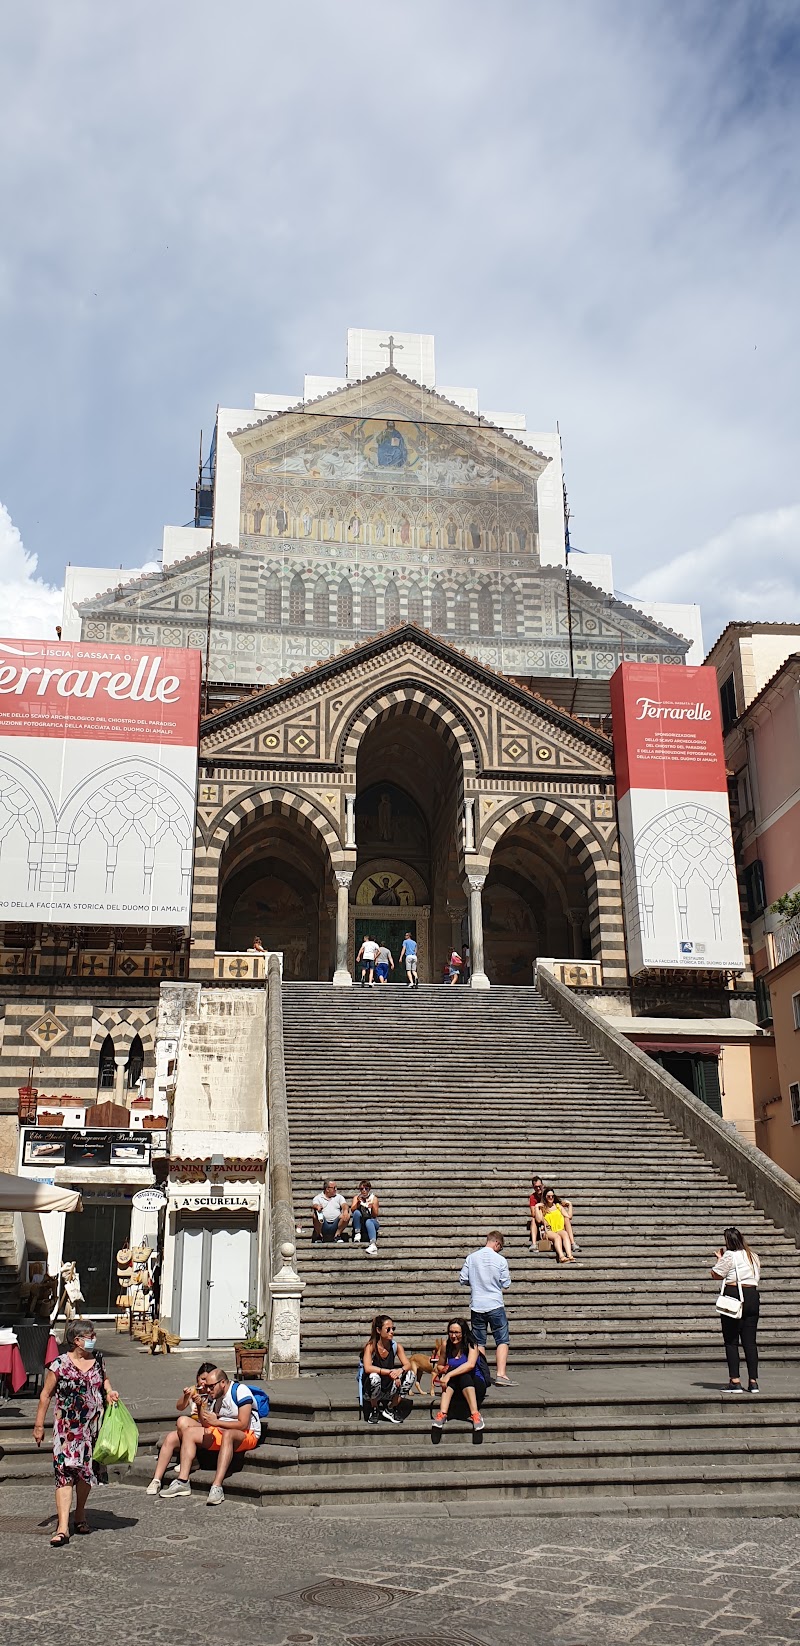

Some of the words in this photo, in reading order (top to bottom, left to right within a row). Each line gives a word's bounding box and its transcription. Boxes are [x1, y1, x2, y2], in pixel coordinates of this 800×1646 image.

[40, 649, 73, 658] LISCIA,
[76, 651, 121, 660] GASSATA
[636, 697, 712, 720] Ferrarelle
[70, 1133, 107, 1142] Management
[116, 1133, 148, 1142] Brokerage
